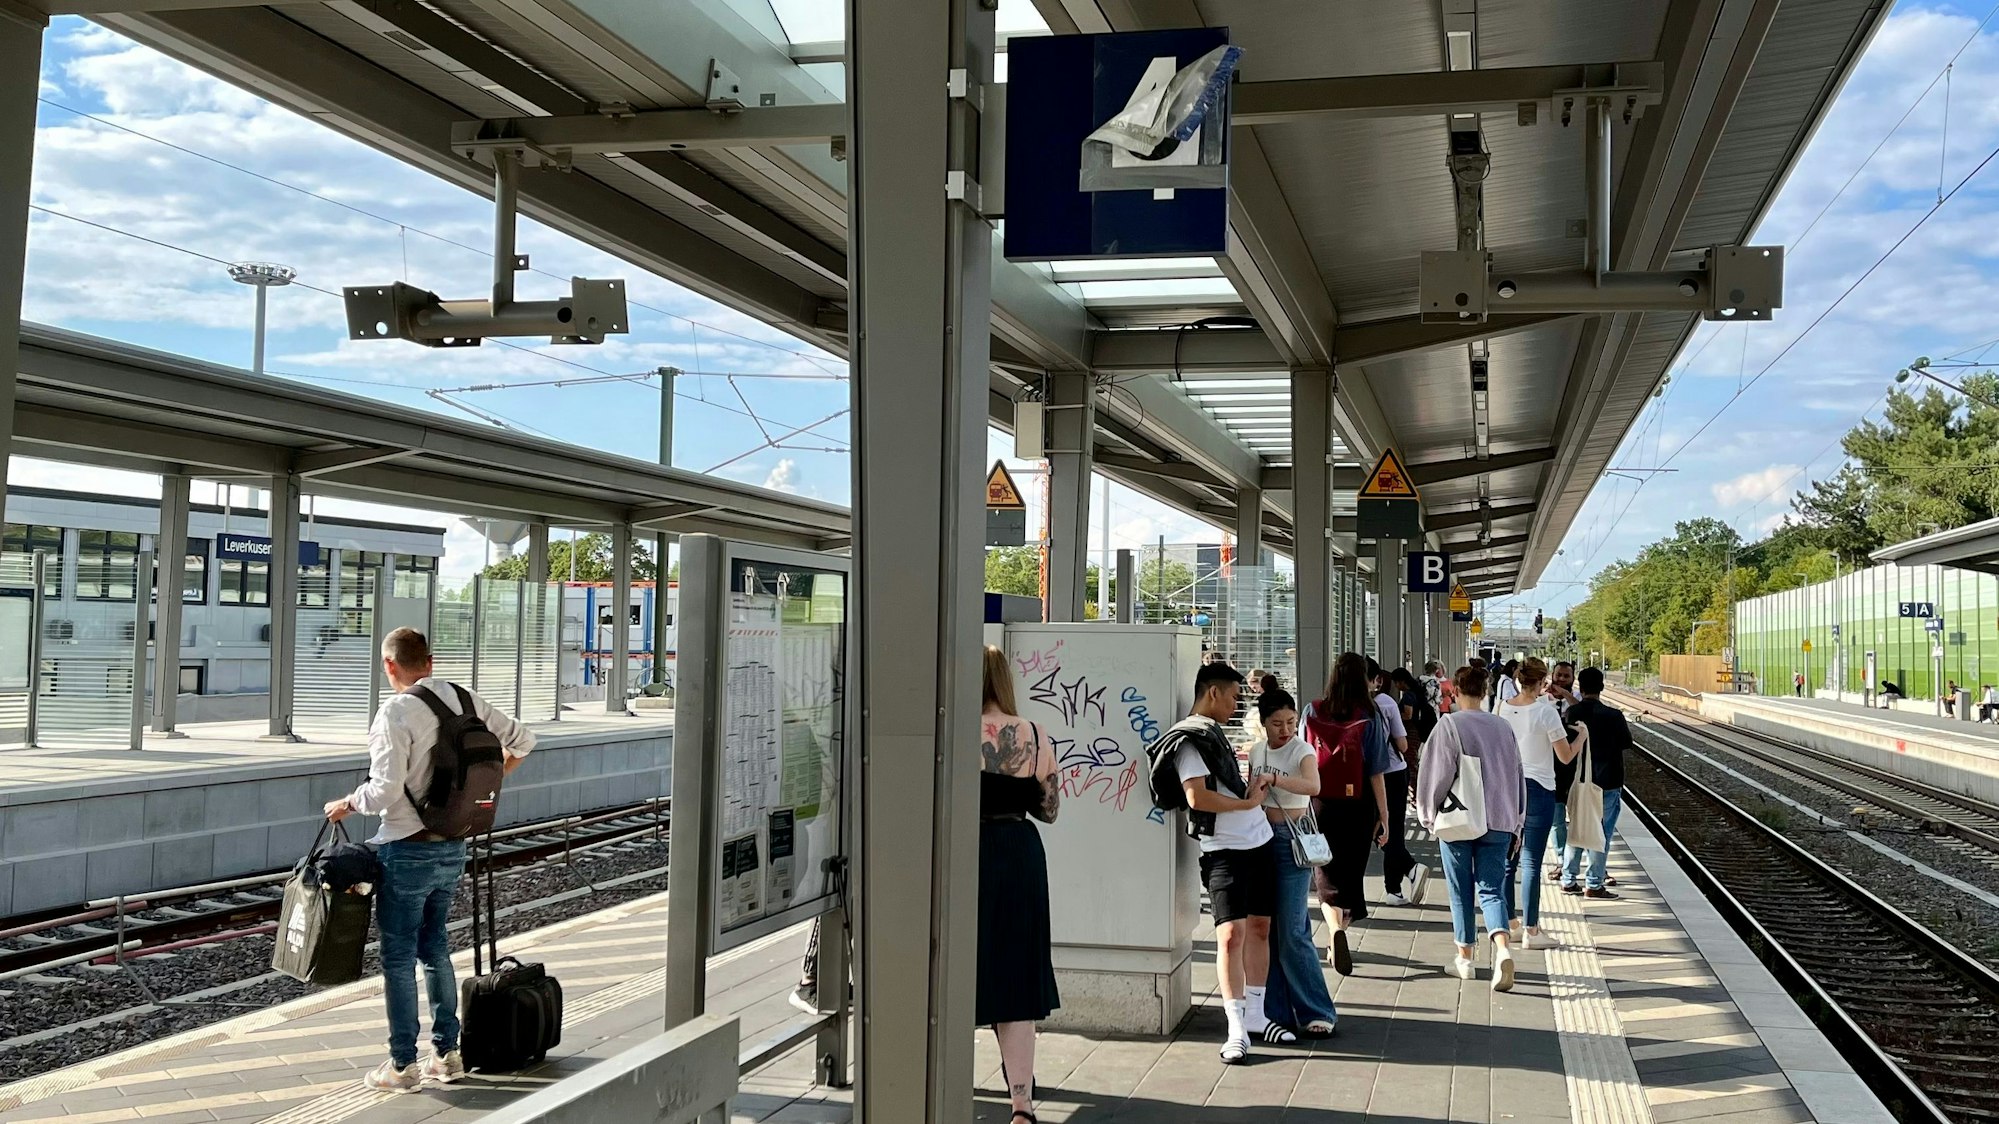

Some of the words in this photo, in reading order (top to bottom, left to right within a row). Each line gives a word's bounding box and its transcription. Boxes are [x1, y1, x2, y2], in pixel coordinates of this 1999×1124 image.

[1423, 555, 1445, 584] B
[1901, 603, 1910, 615] 5
[1919, 603, 1930, 616] A
[286, 929, 305, 949] ALDI
